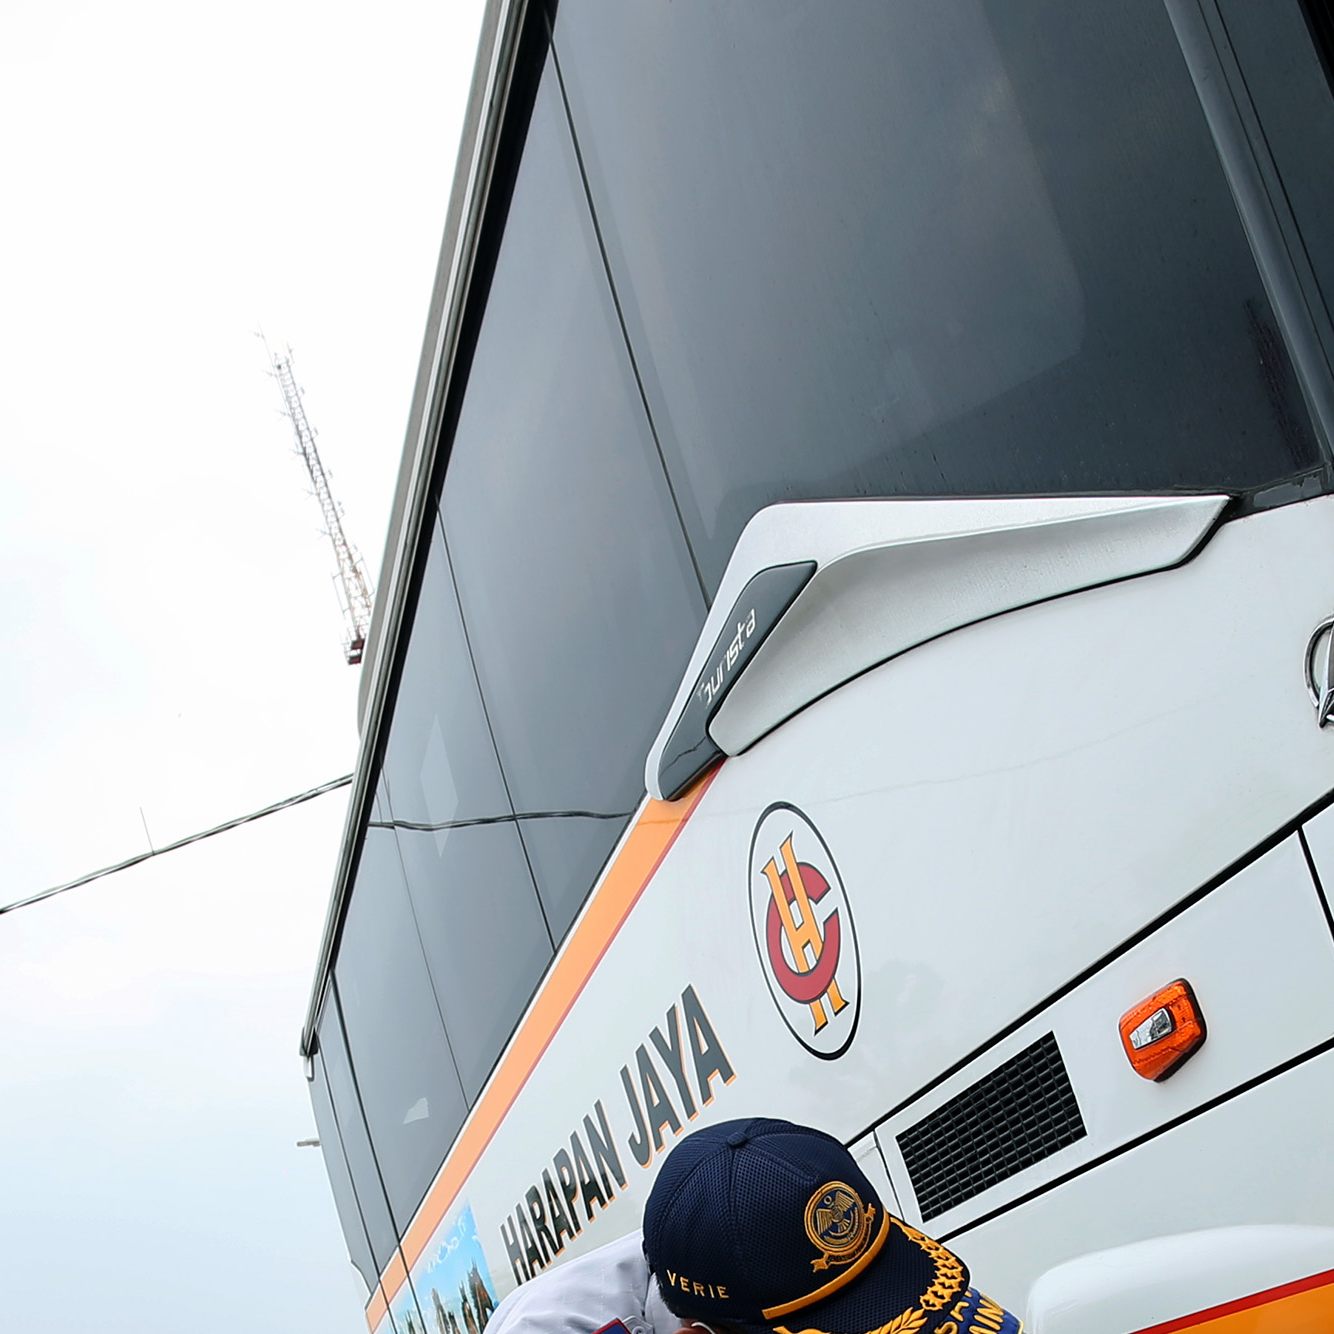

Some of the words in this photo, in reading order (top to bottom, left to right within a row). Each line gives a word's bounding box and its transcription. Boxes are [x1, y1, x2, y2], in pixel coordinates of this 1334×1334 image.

[499, 1099, 628, 1285] HARAPAN
[620, 984, 737, 1168] JAYA
[666, 1269, 730, 1300] VERIE
